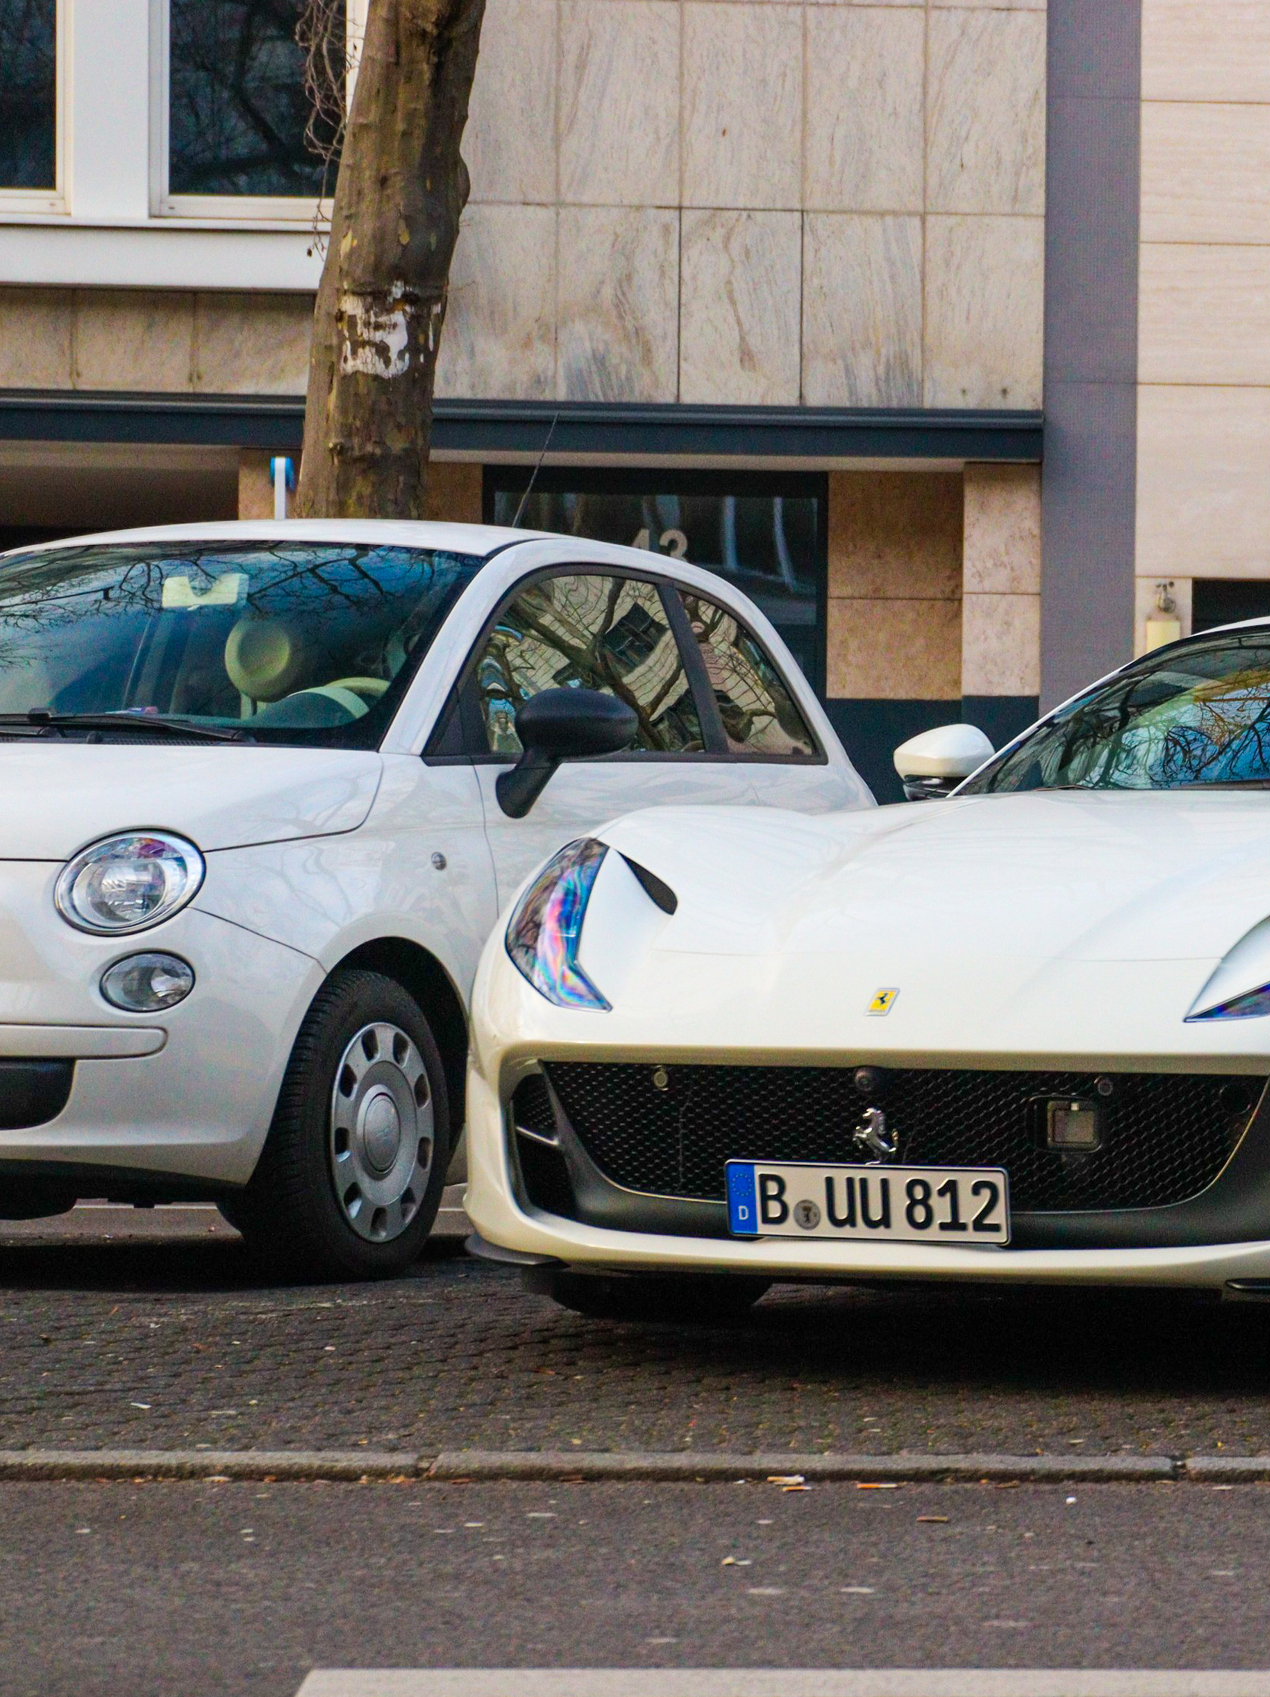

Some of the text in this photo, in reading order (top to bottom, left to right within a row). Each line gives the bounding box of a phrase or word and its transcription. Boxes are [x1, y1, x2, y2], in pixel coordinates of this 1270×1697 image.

[738, 1205, 749, 1220] D
[758, 1173, 1002, 1233] B UU 812
